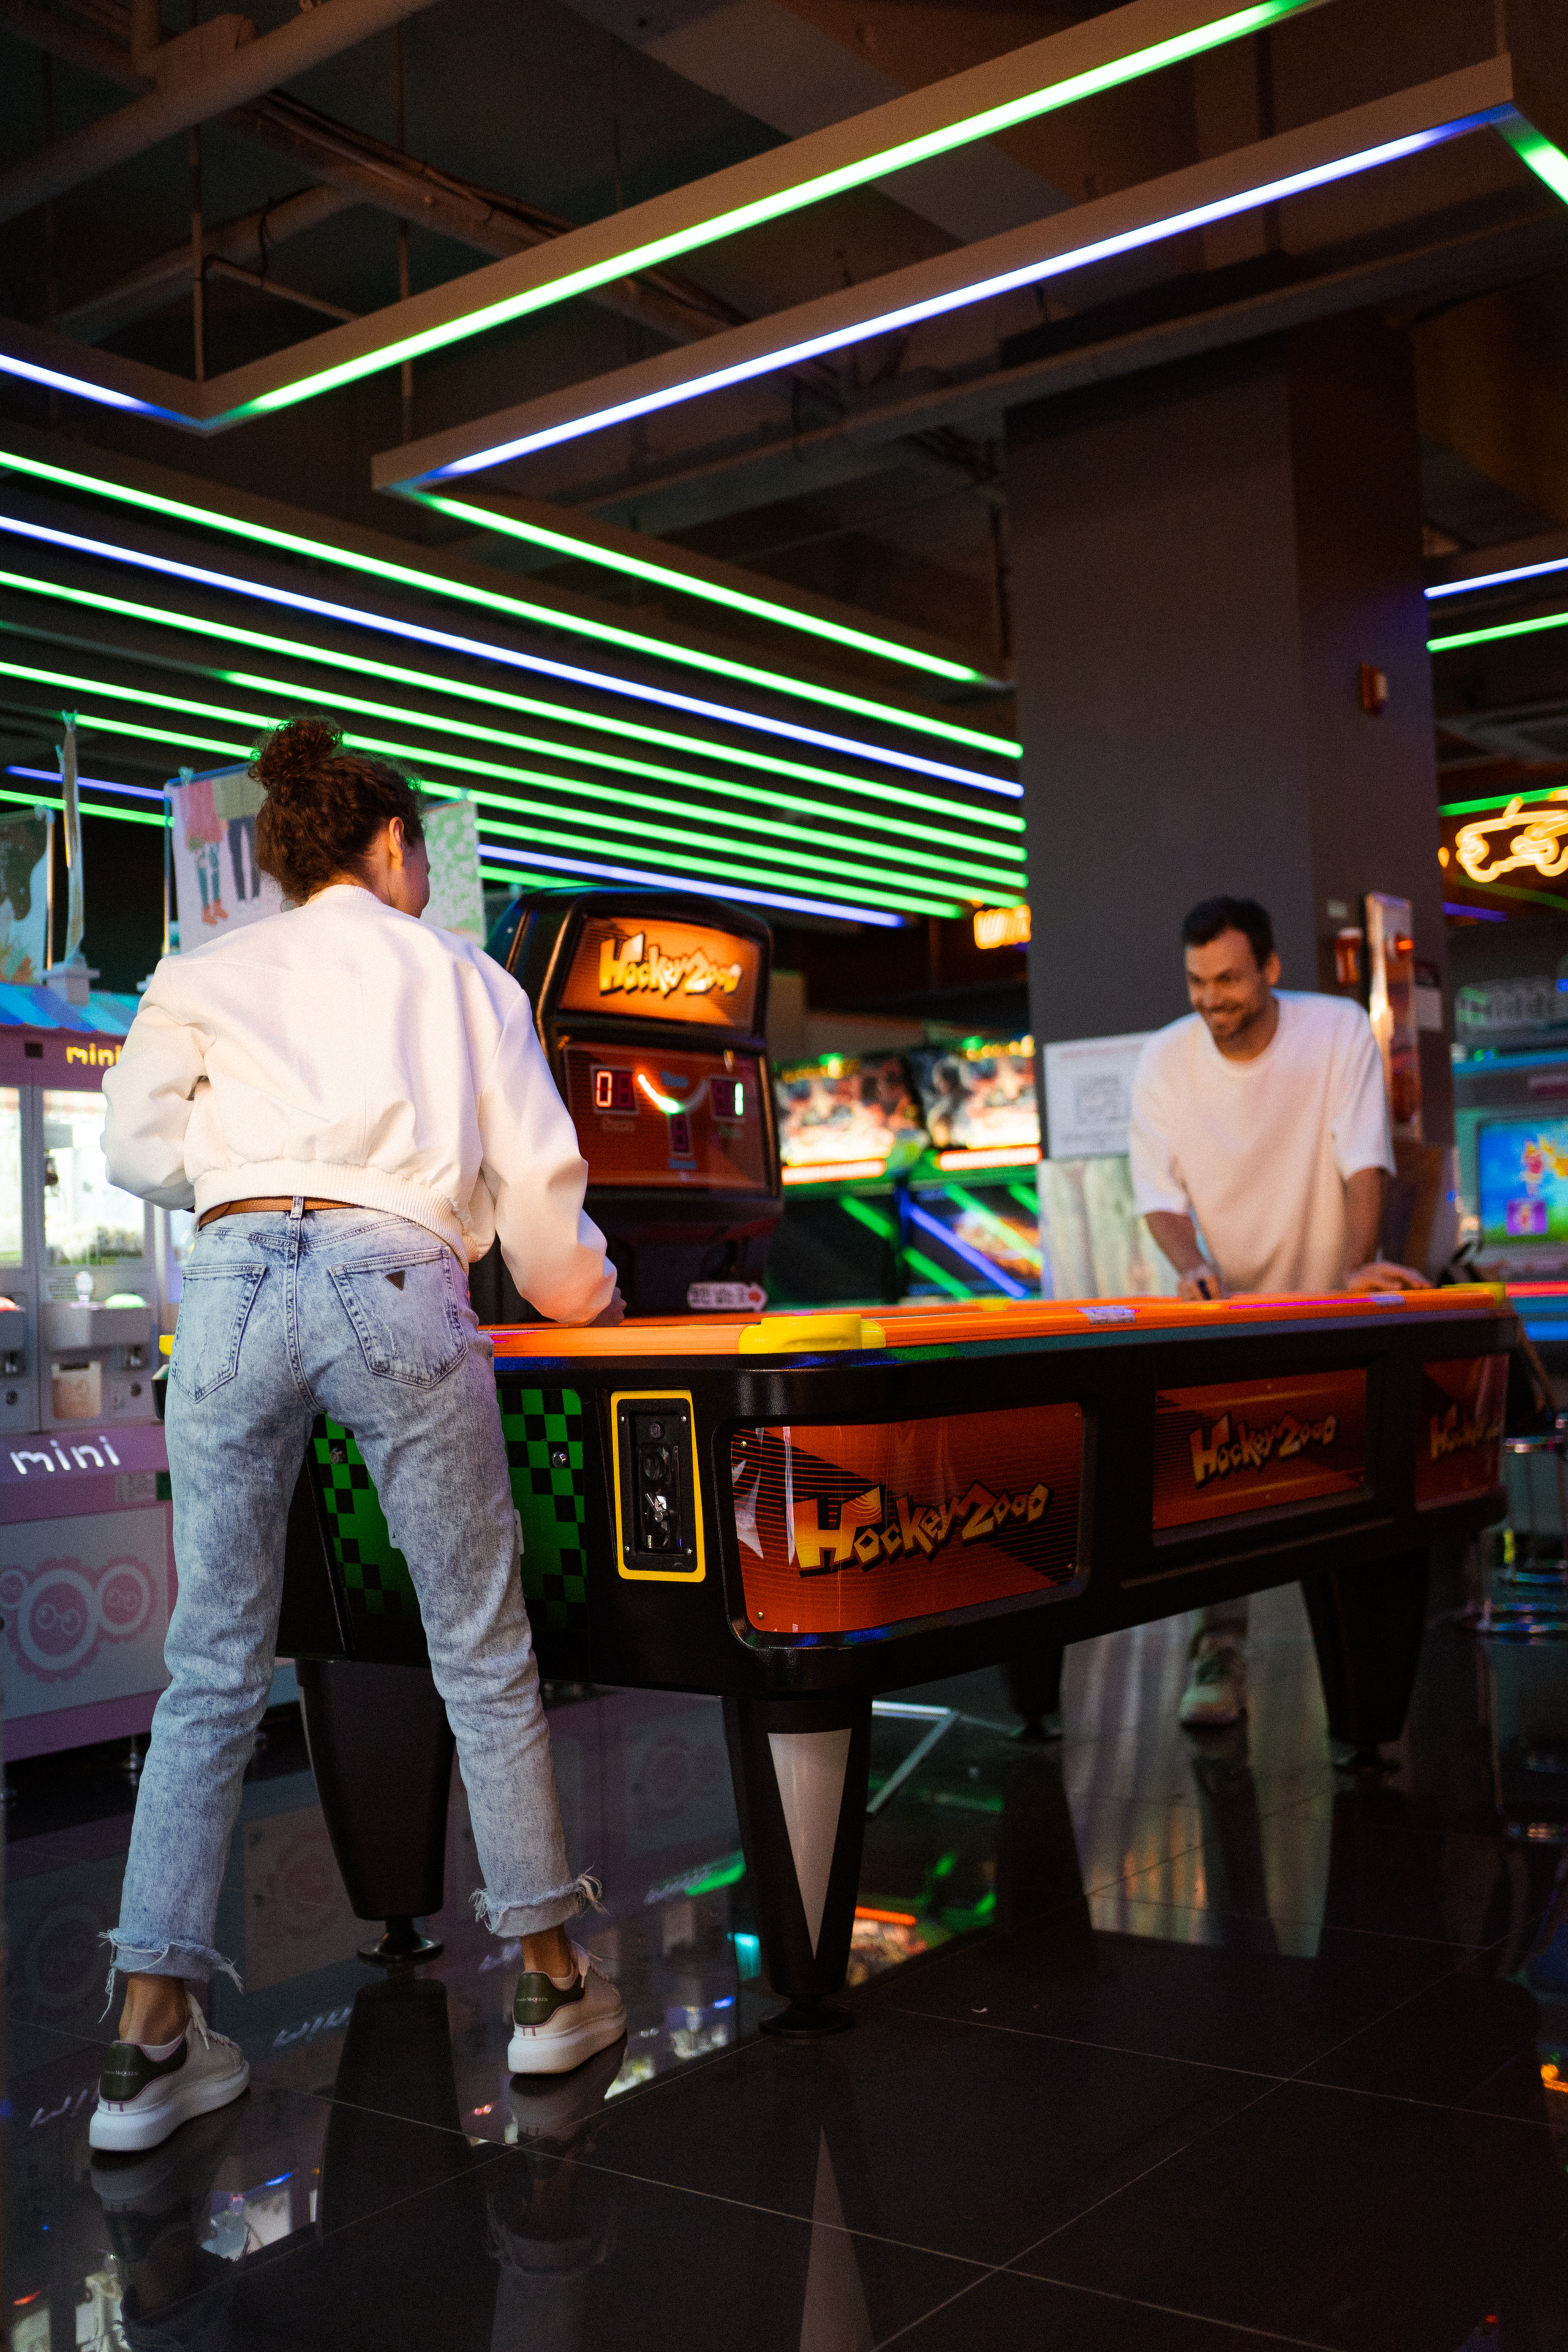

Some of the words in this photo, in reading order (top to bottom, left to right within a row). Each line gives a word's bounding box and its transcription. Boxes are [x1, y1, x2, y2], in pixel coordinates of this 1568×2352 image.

[66, 1042, 122, 1066] mini
[596, 1071, 612, 1107] 0
[9, 1434, 121, 1475] mini
